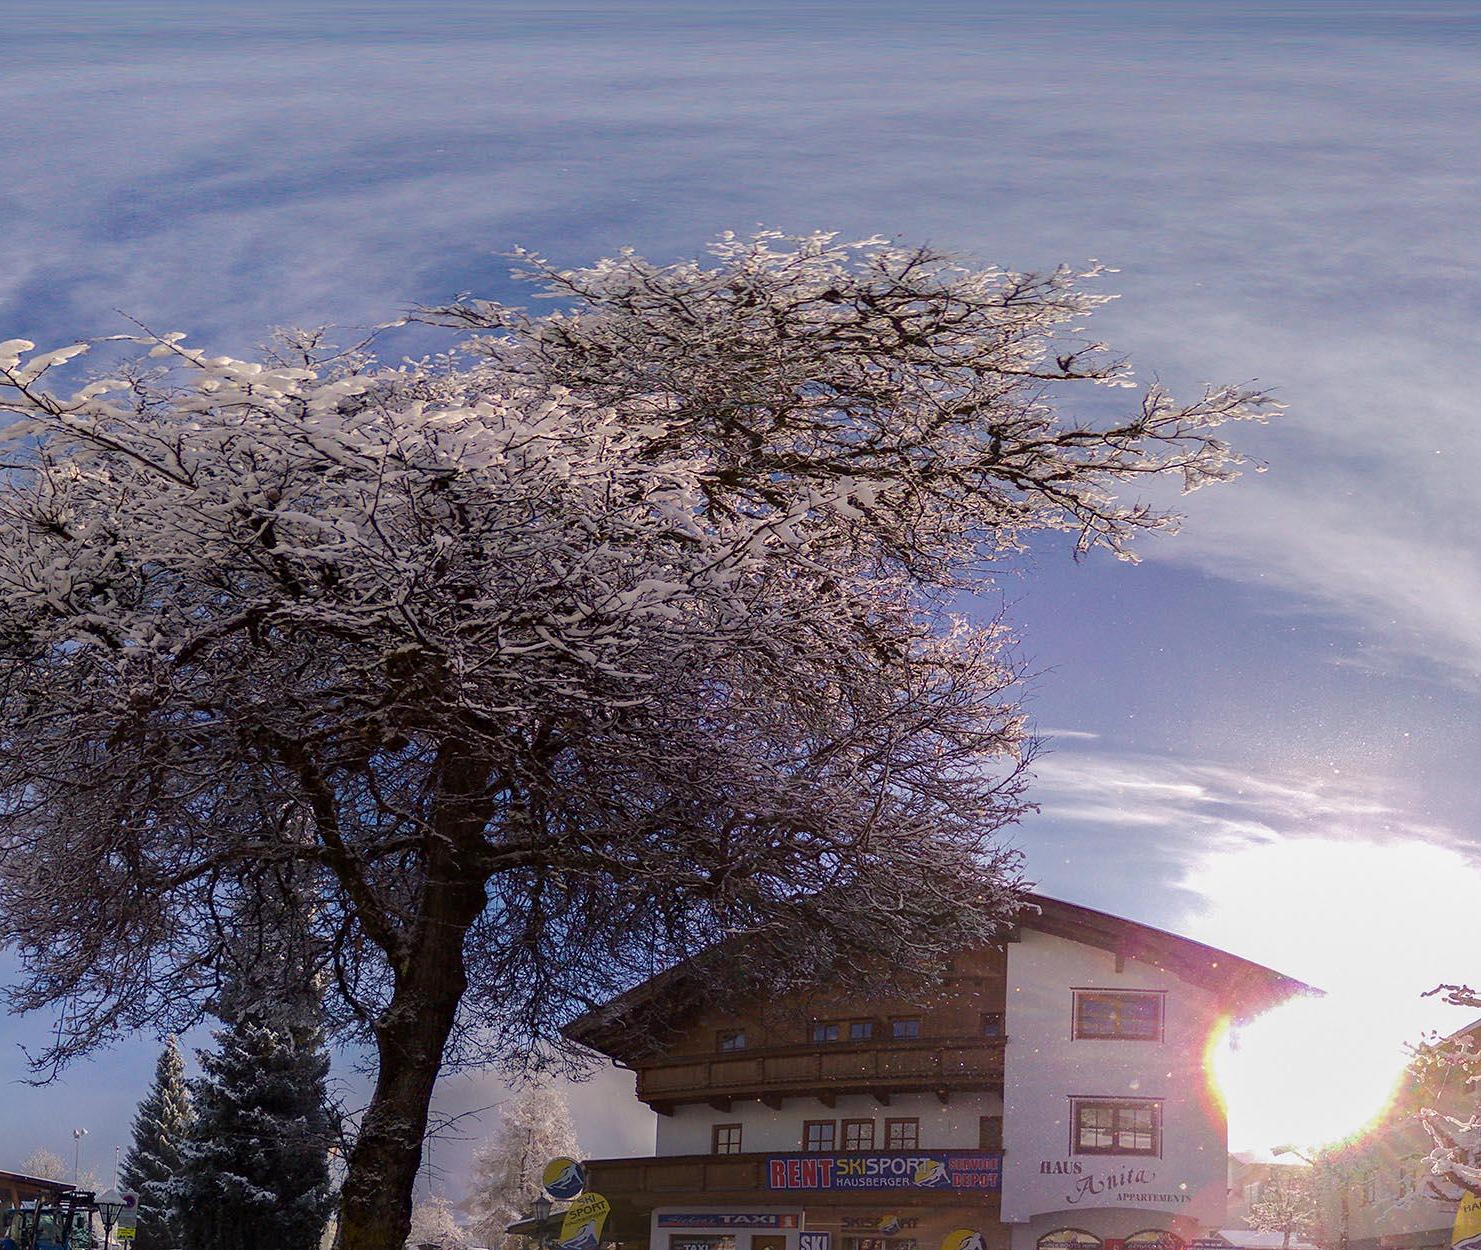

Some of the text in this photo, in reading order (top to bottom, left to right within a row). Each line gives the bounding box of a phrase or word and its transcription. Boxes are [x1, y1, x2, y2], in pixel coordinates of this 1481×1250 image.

[769, 1158, 834, 1189] RENT
[1039, 1161, 1082, 1174] HAUS
[836, 1173, 998, 1188] HAUSBERGER DEPOT
[1067, 1165, 1150, 1204] Anita
[569, 1200, 607, 1220] SPORT
[719, 1214, 776, 1224] TAXI
